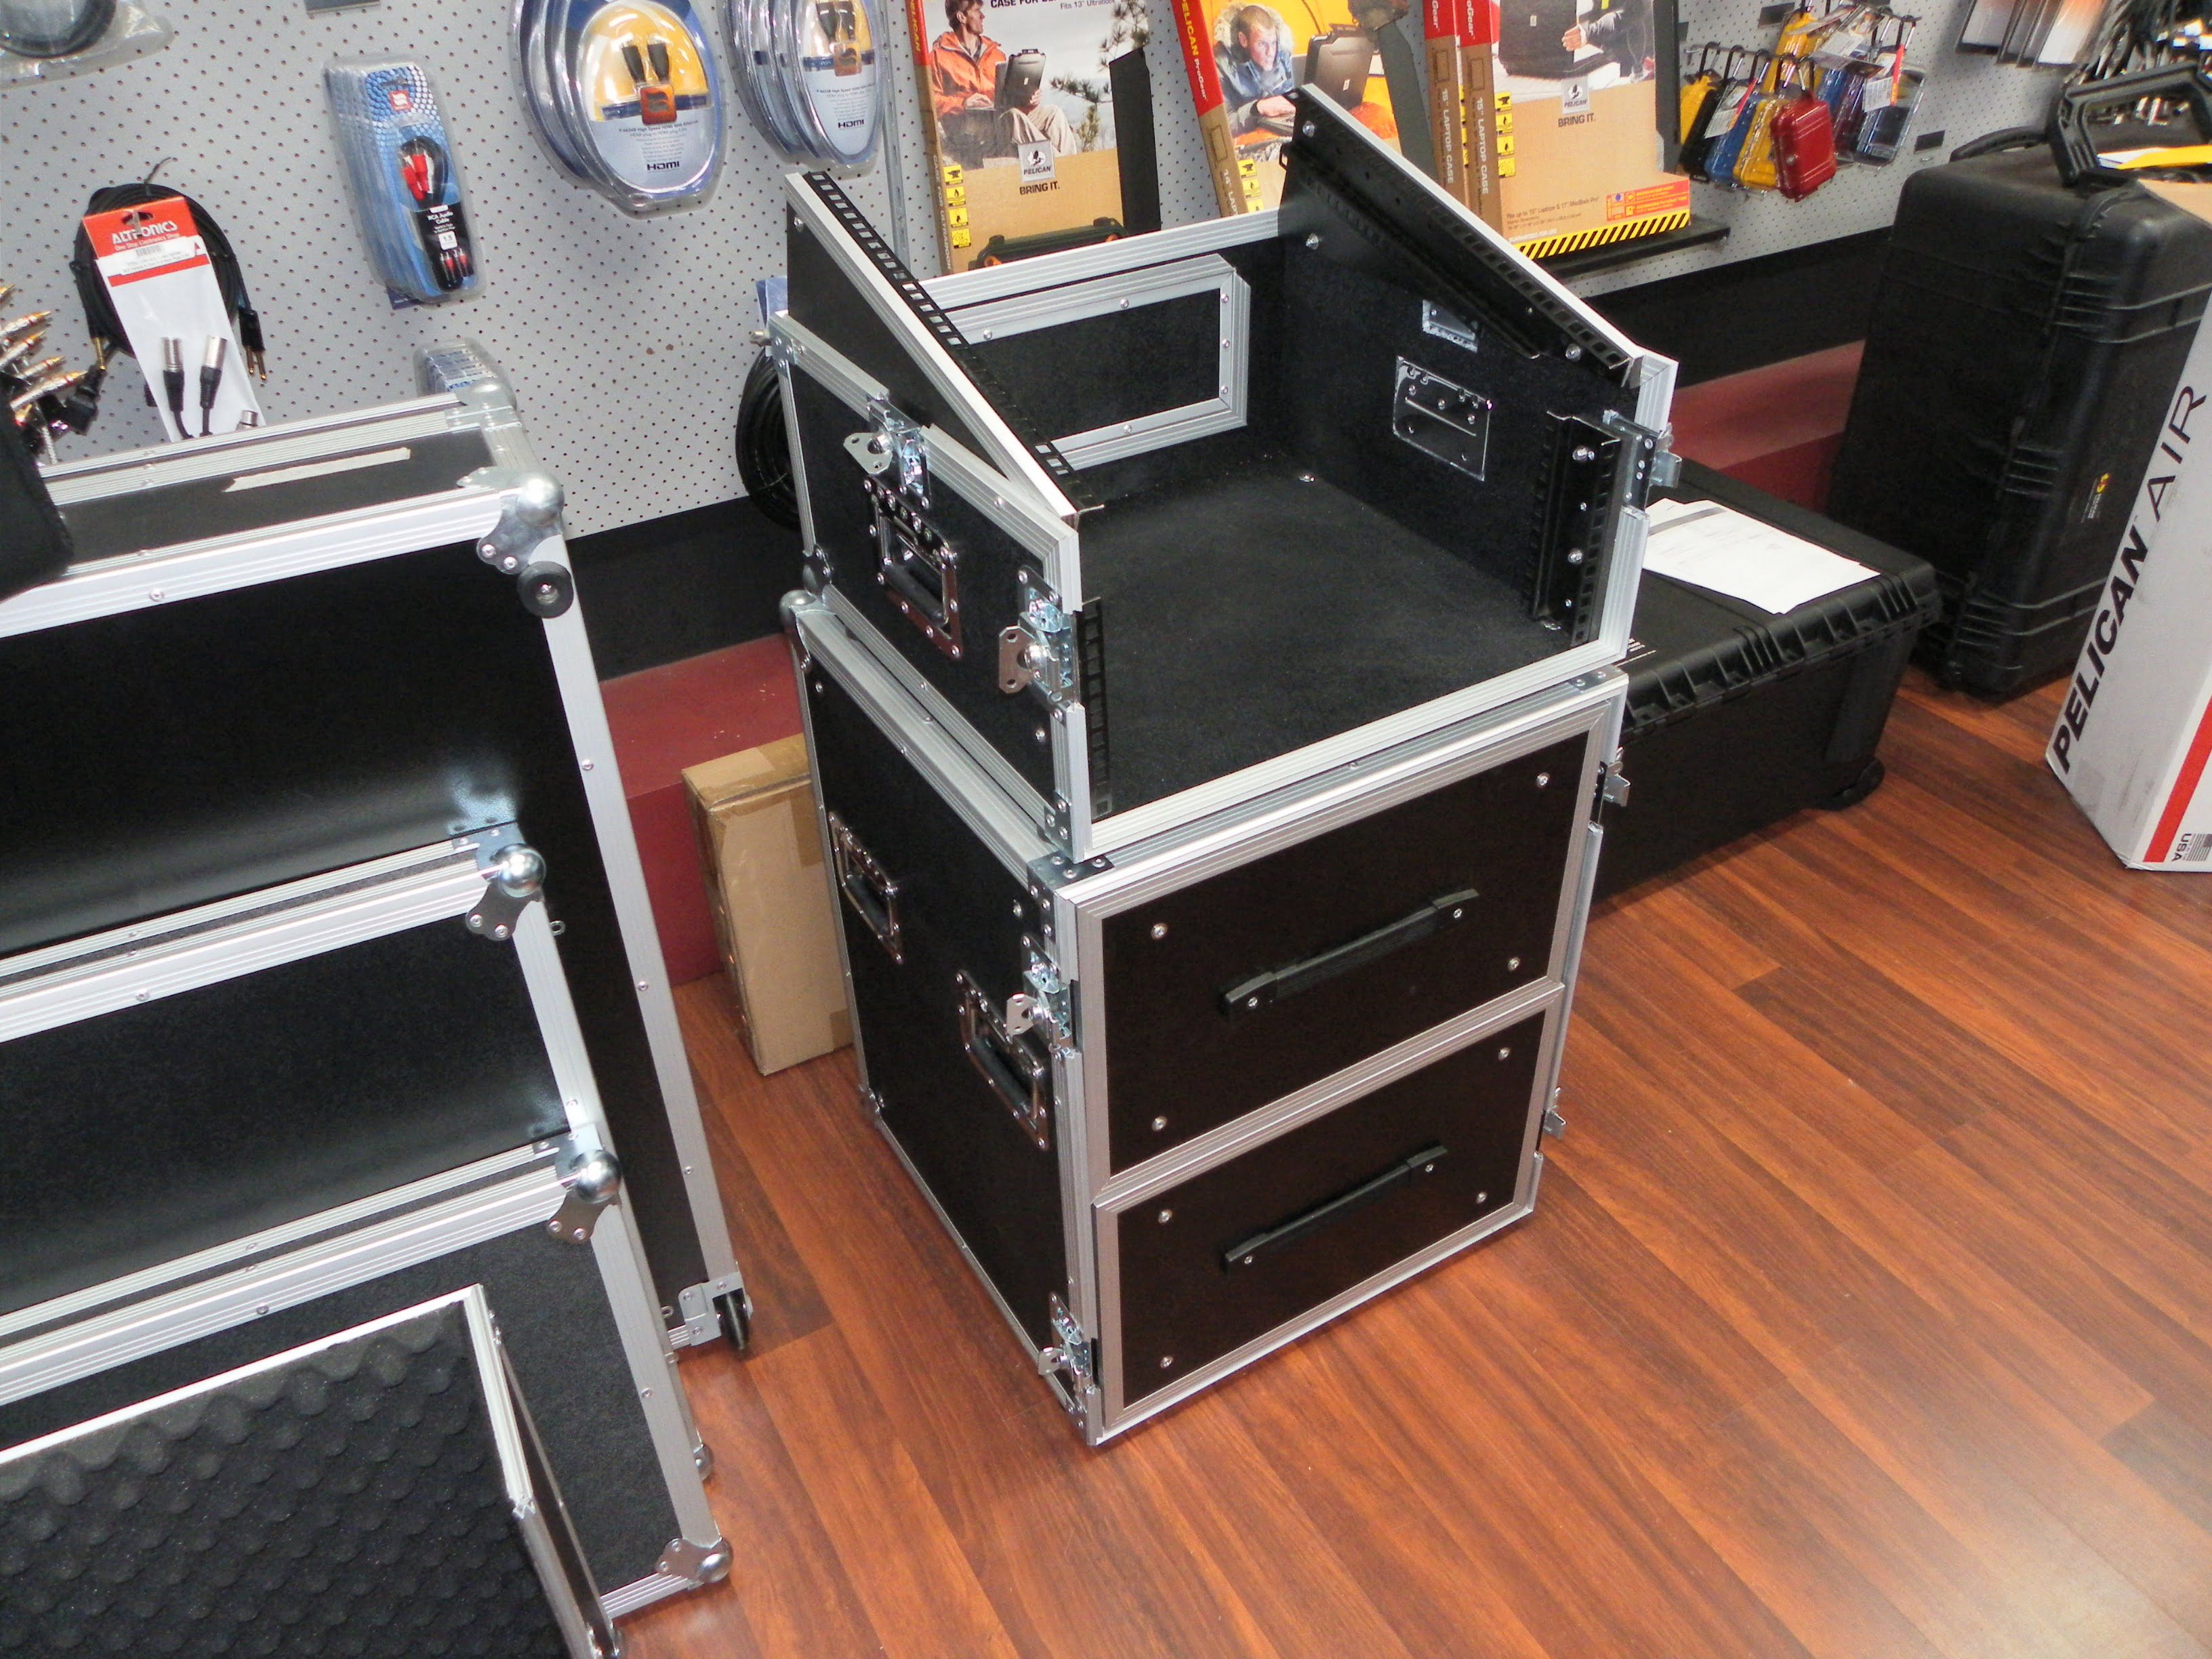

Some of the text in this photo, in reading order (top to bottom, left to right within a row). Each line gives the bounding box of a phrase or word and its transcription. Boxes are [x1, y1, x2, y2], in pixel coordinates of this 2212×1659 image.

[990, 0, 1017, 8] CASE
[1181, 0, 1199, 56] ELICAN
[1194, 58, 1207, 100] ProGear
[1564, 99, 1587, 108] PELICAN
[838, 119, 864, 128] HDMI
[1443, 110, 1452, 152] LAPTOP
[1558, 112, 1596, 127] BRING IT.
[1478, 119, 1486, 161] LAPTOP
[647, 161, 680, 171] HDMI
[1023, 165, 1052, 175] PELICAN
[1481, 165, 1489, 194] CASE
[1019, 181, 1060, 195] BRING IT.
[940, 210, 951, 270] ULTRABOOK
[2053, 385, 2207, 774] PELICAN AIR
[2171, 833, 2192, 862] USA
